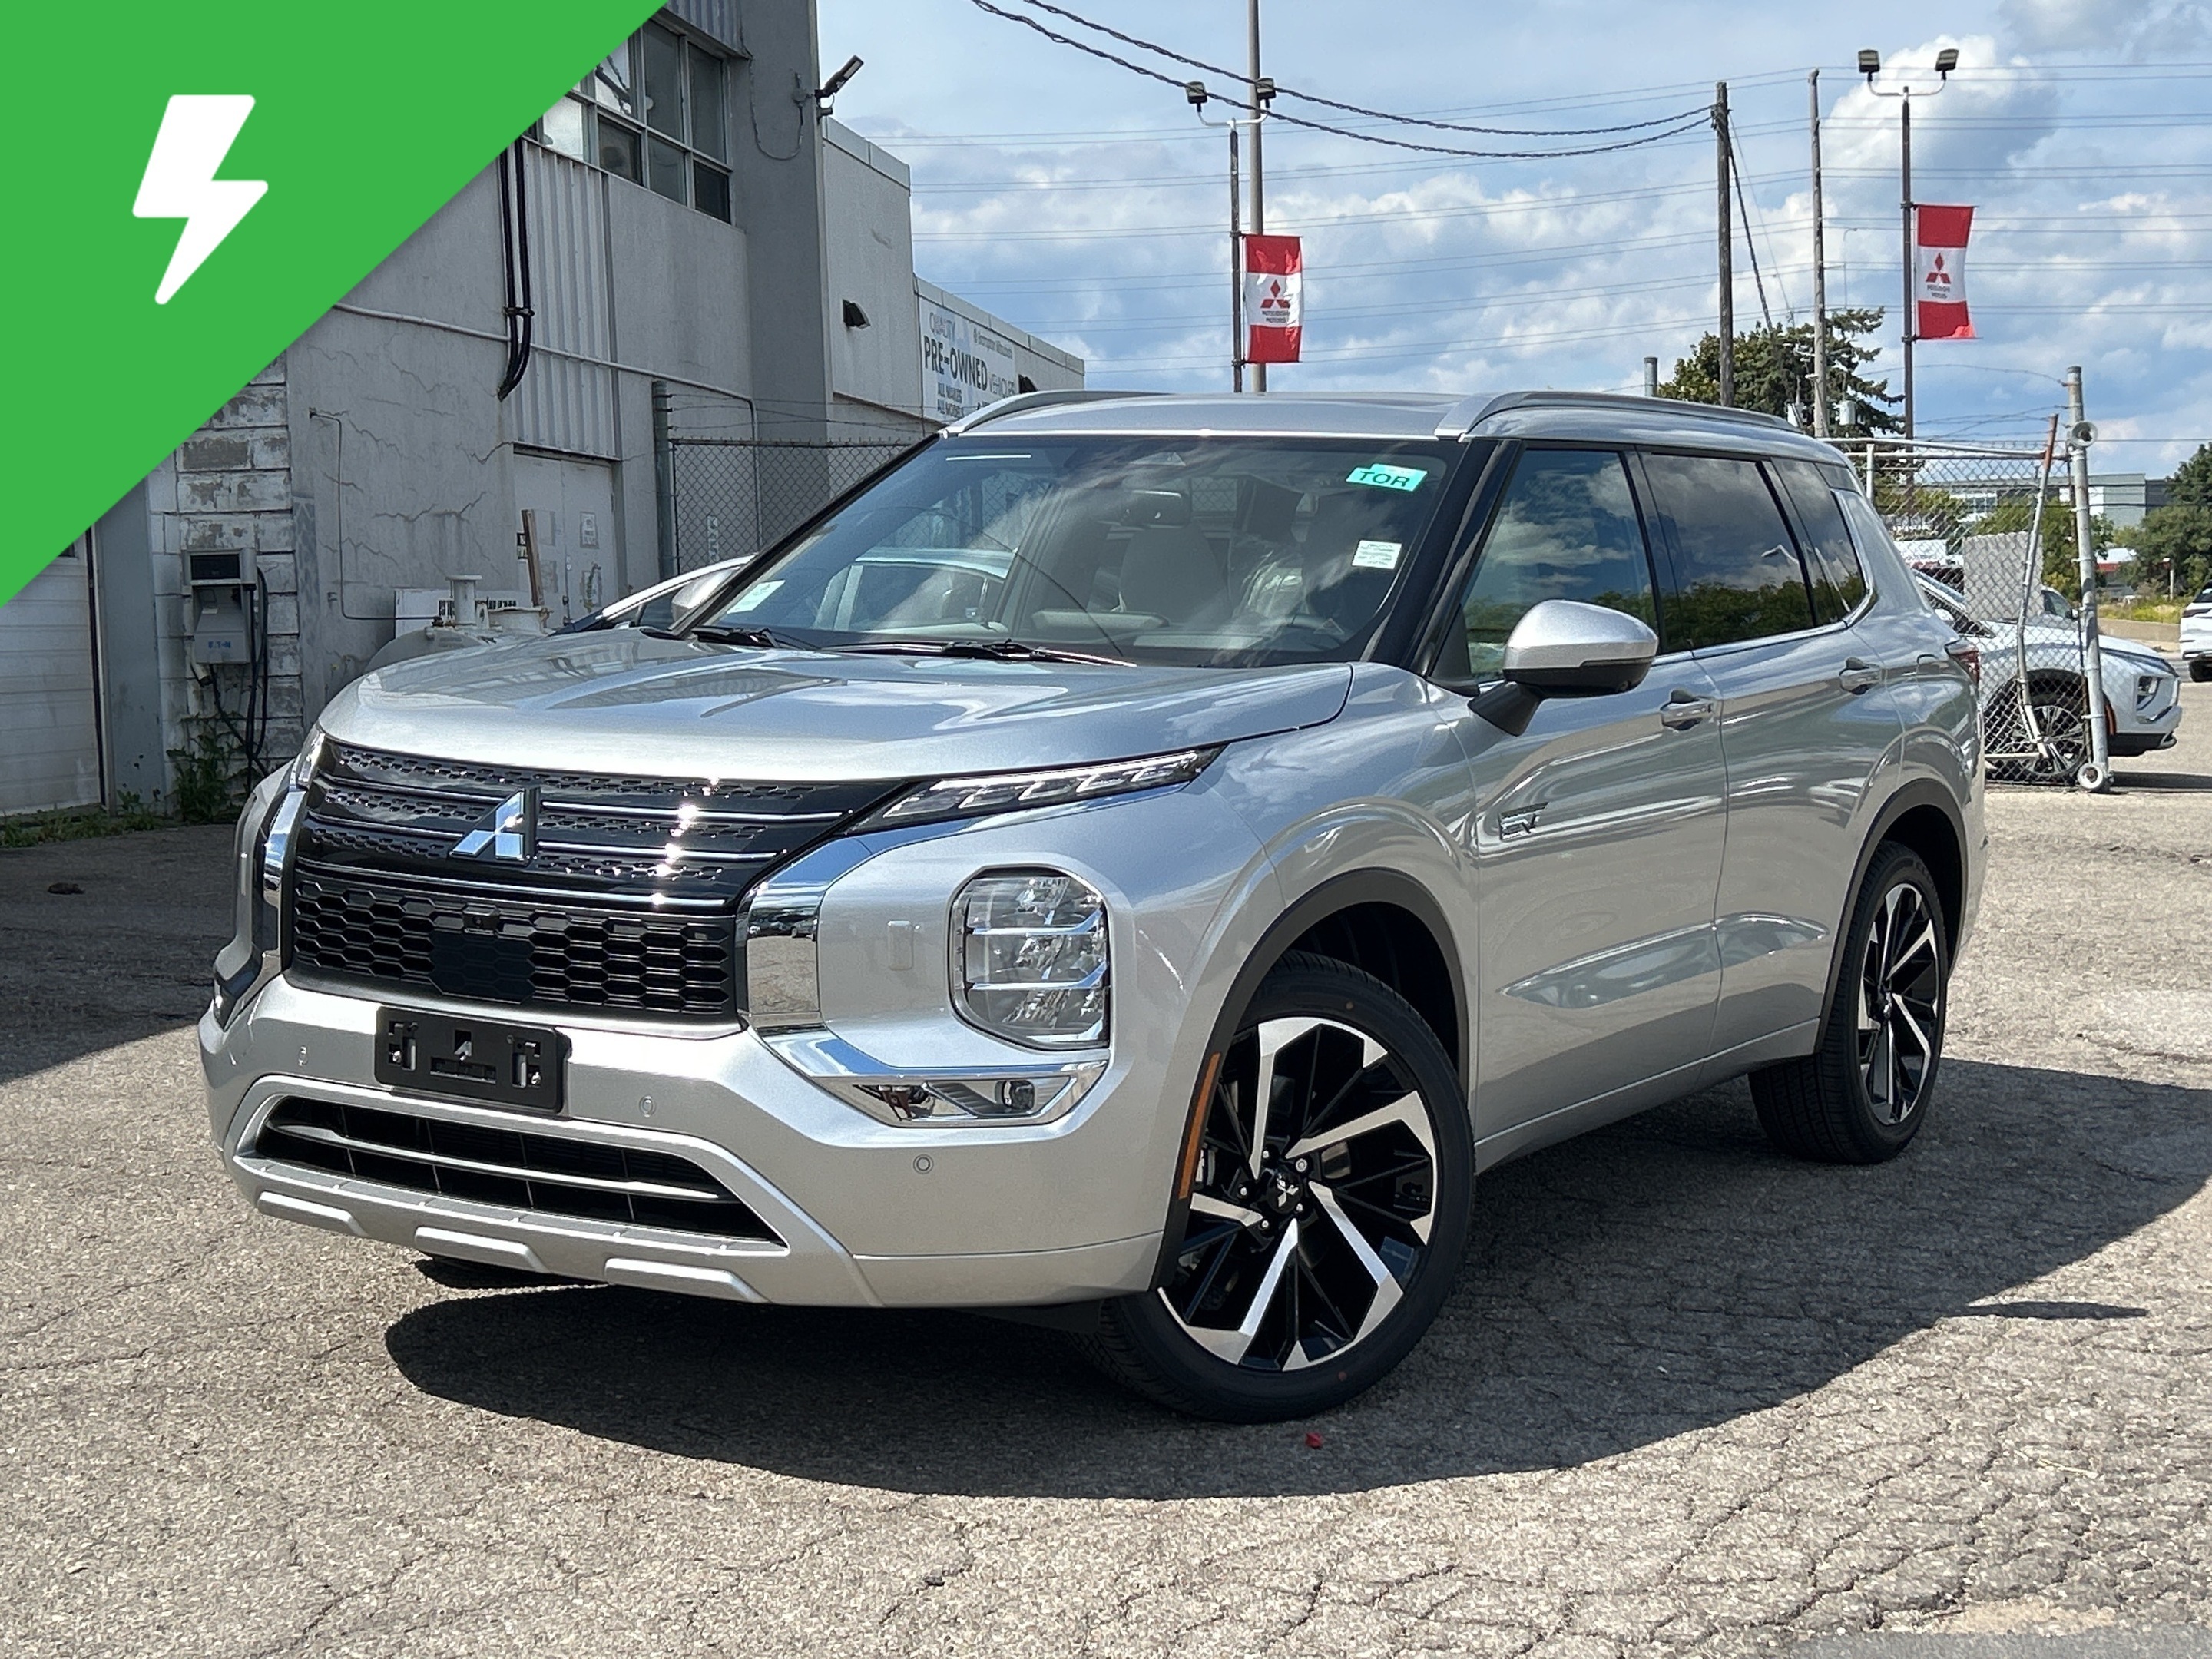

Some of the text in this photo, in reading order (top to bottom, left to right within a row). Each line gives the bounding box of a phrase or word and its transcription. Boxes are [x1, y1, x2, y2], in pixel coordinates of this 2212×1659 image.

[923, 335, 988, 392] PRE-OWNED
[1359, 470, 1410, 488] TOR
[1498, 812, 1538, 840] EV
